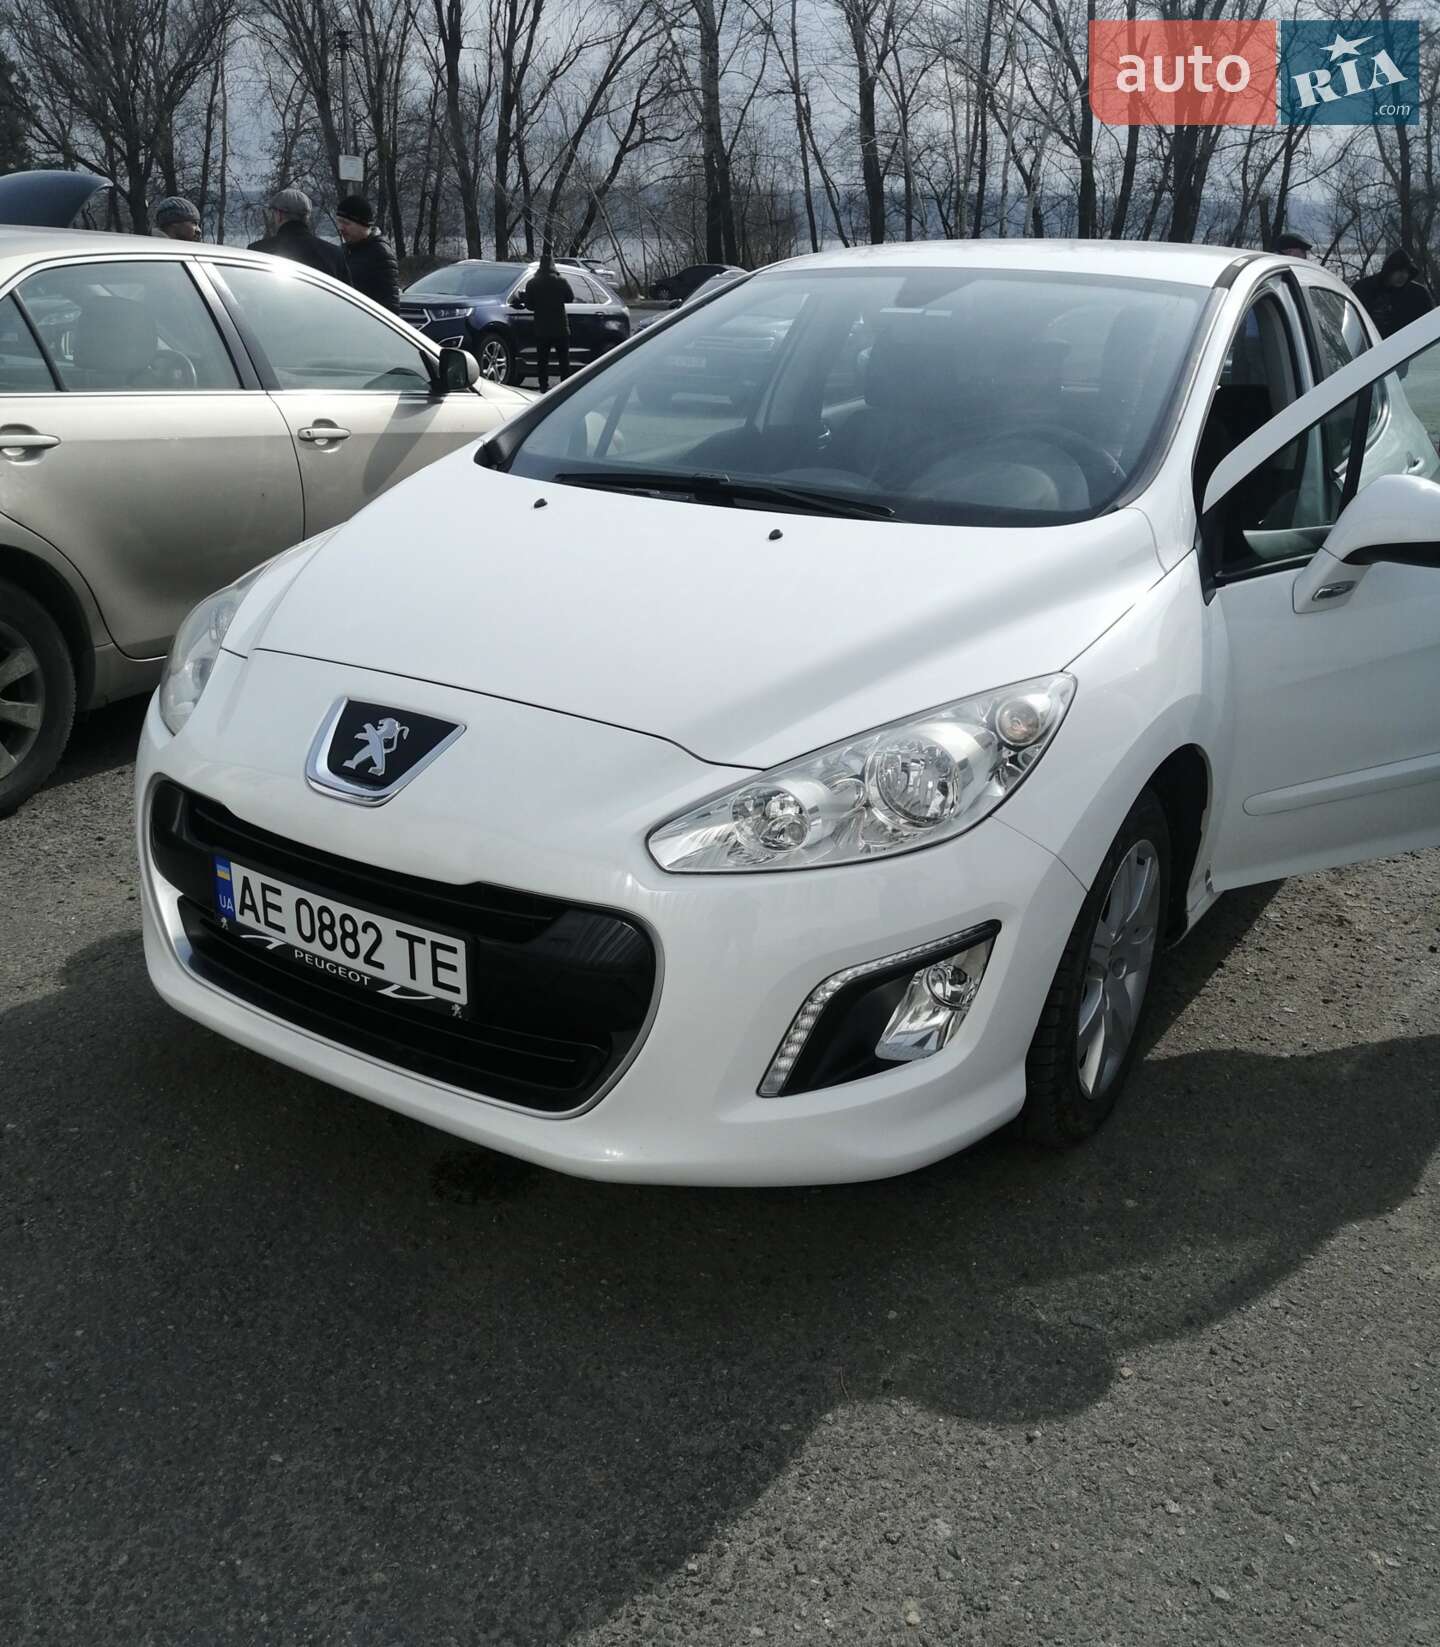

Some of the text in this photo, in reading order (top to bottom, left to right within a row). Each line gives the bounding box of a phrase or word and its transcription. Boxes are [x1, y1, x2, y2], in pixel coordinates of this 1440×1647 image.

[219, 894, 235, 912] UA
[238, 875, 462, 995] AE 0882 TE
[294, 949, 372, 987] PEUGEOT
